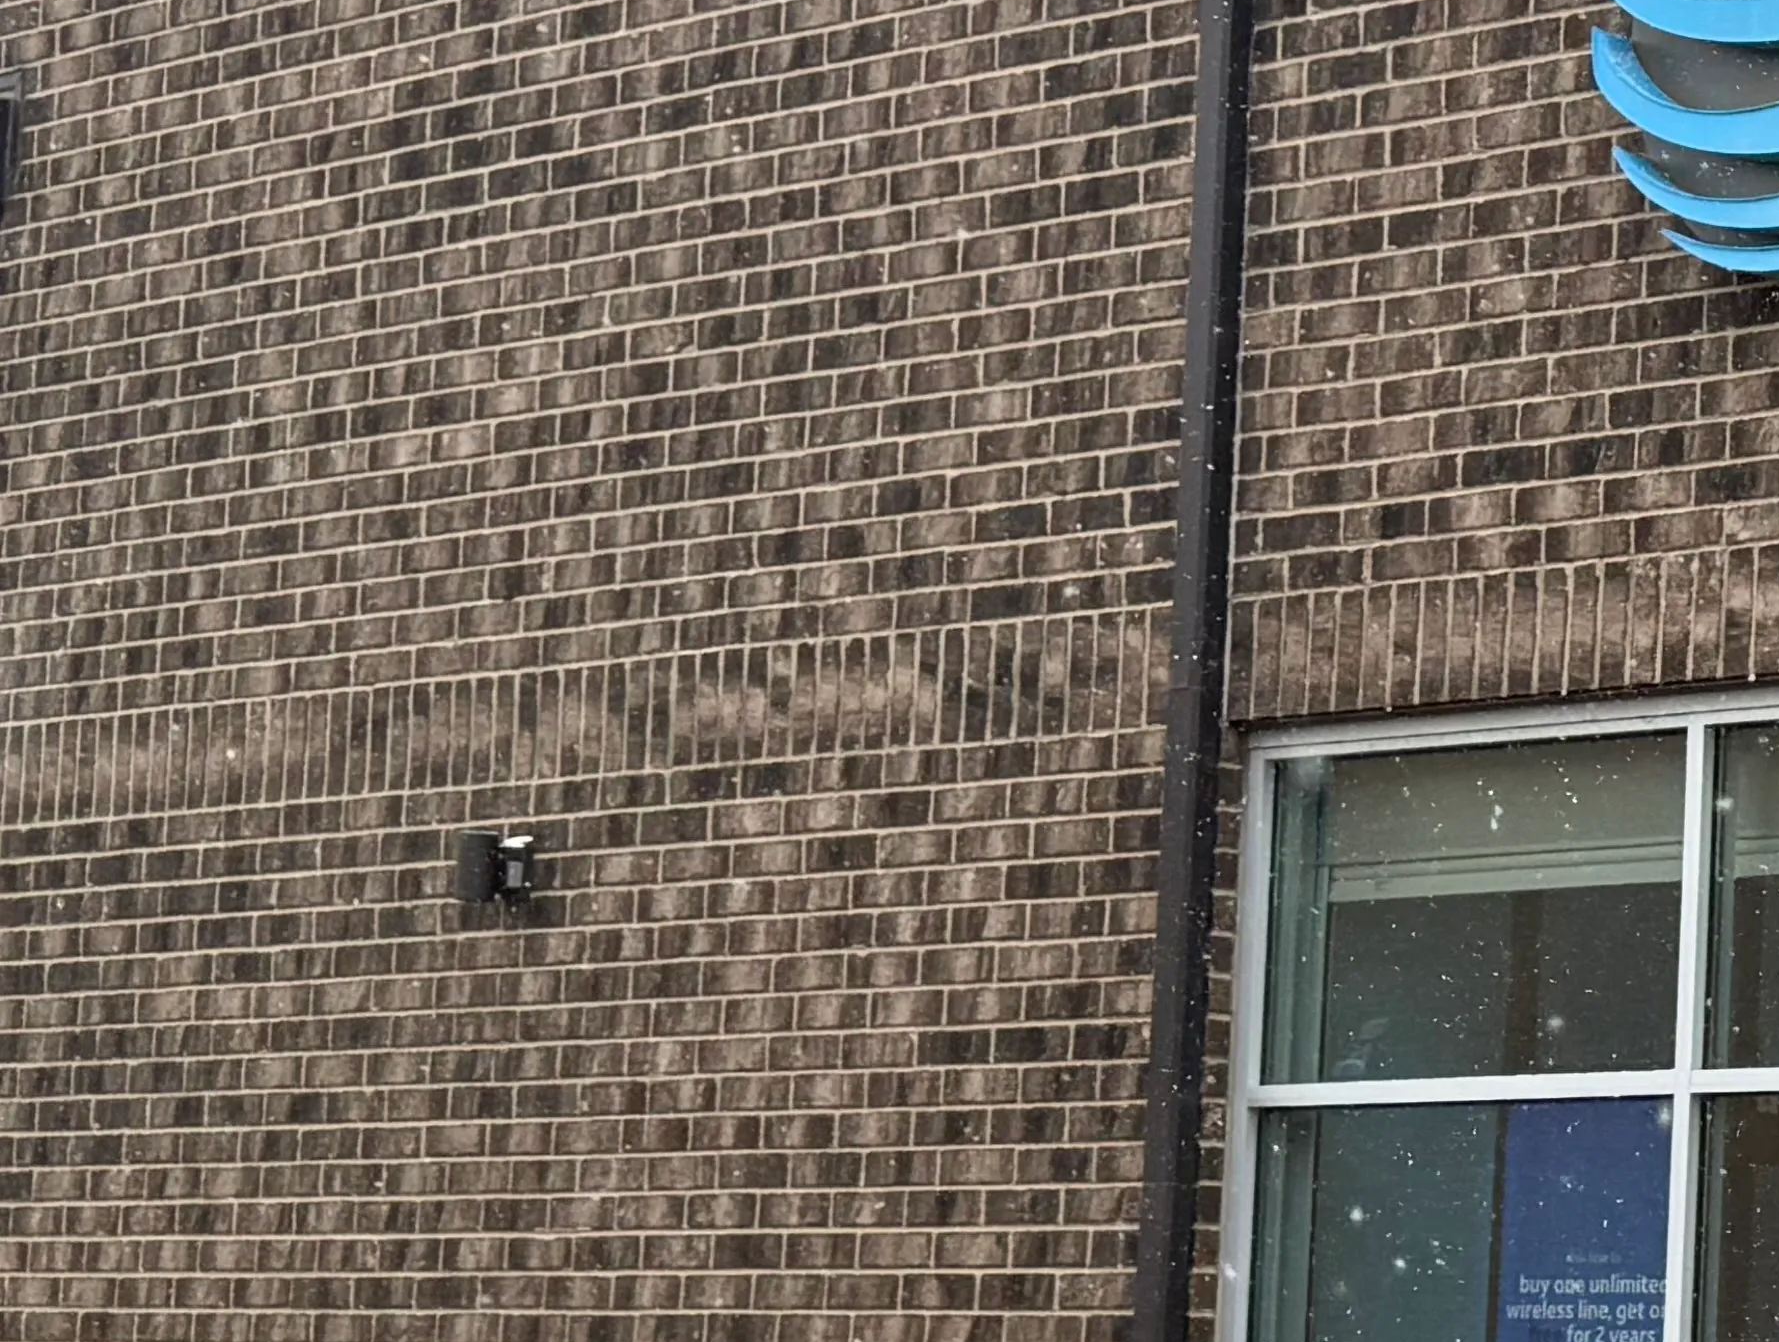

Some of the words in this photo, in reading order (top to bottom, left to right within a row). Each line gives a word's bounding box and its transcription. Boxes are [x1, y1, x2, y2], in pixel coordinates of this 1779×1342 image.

[1519, 1274, 1550, 1298] buy
[1554, 1279, 1585, 1295] one
[1506, 1299, 1574, 1320] wireless
[1616, 1302, 1645, 1325] get
